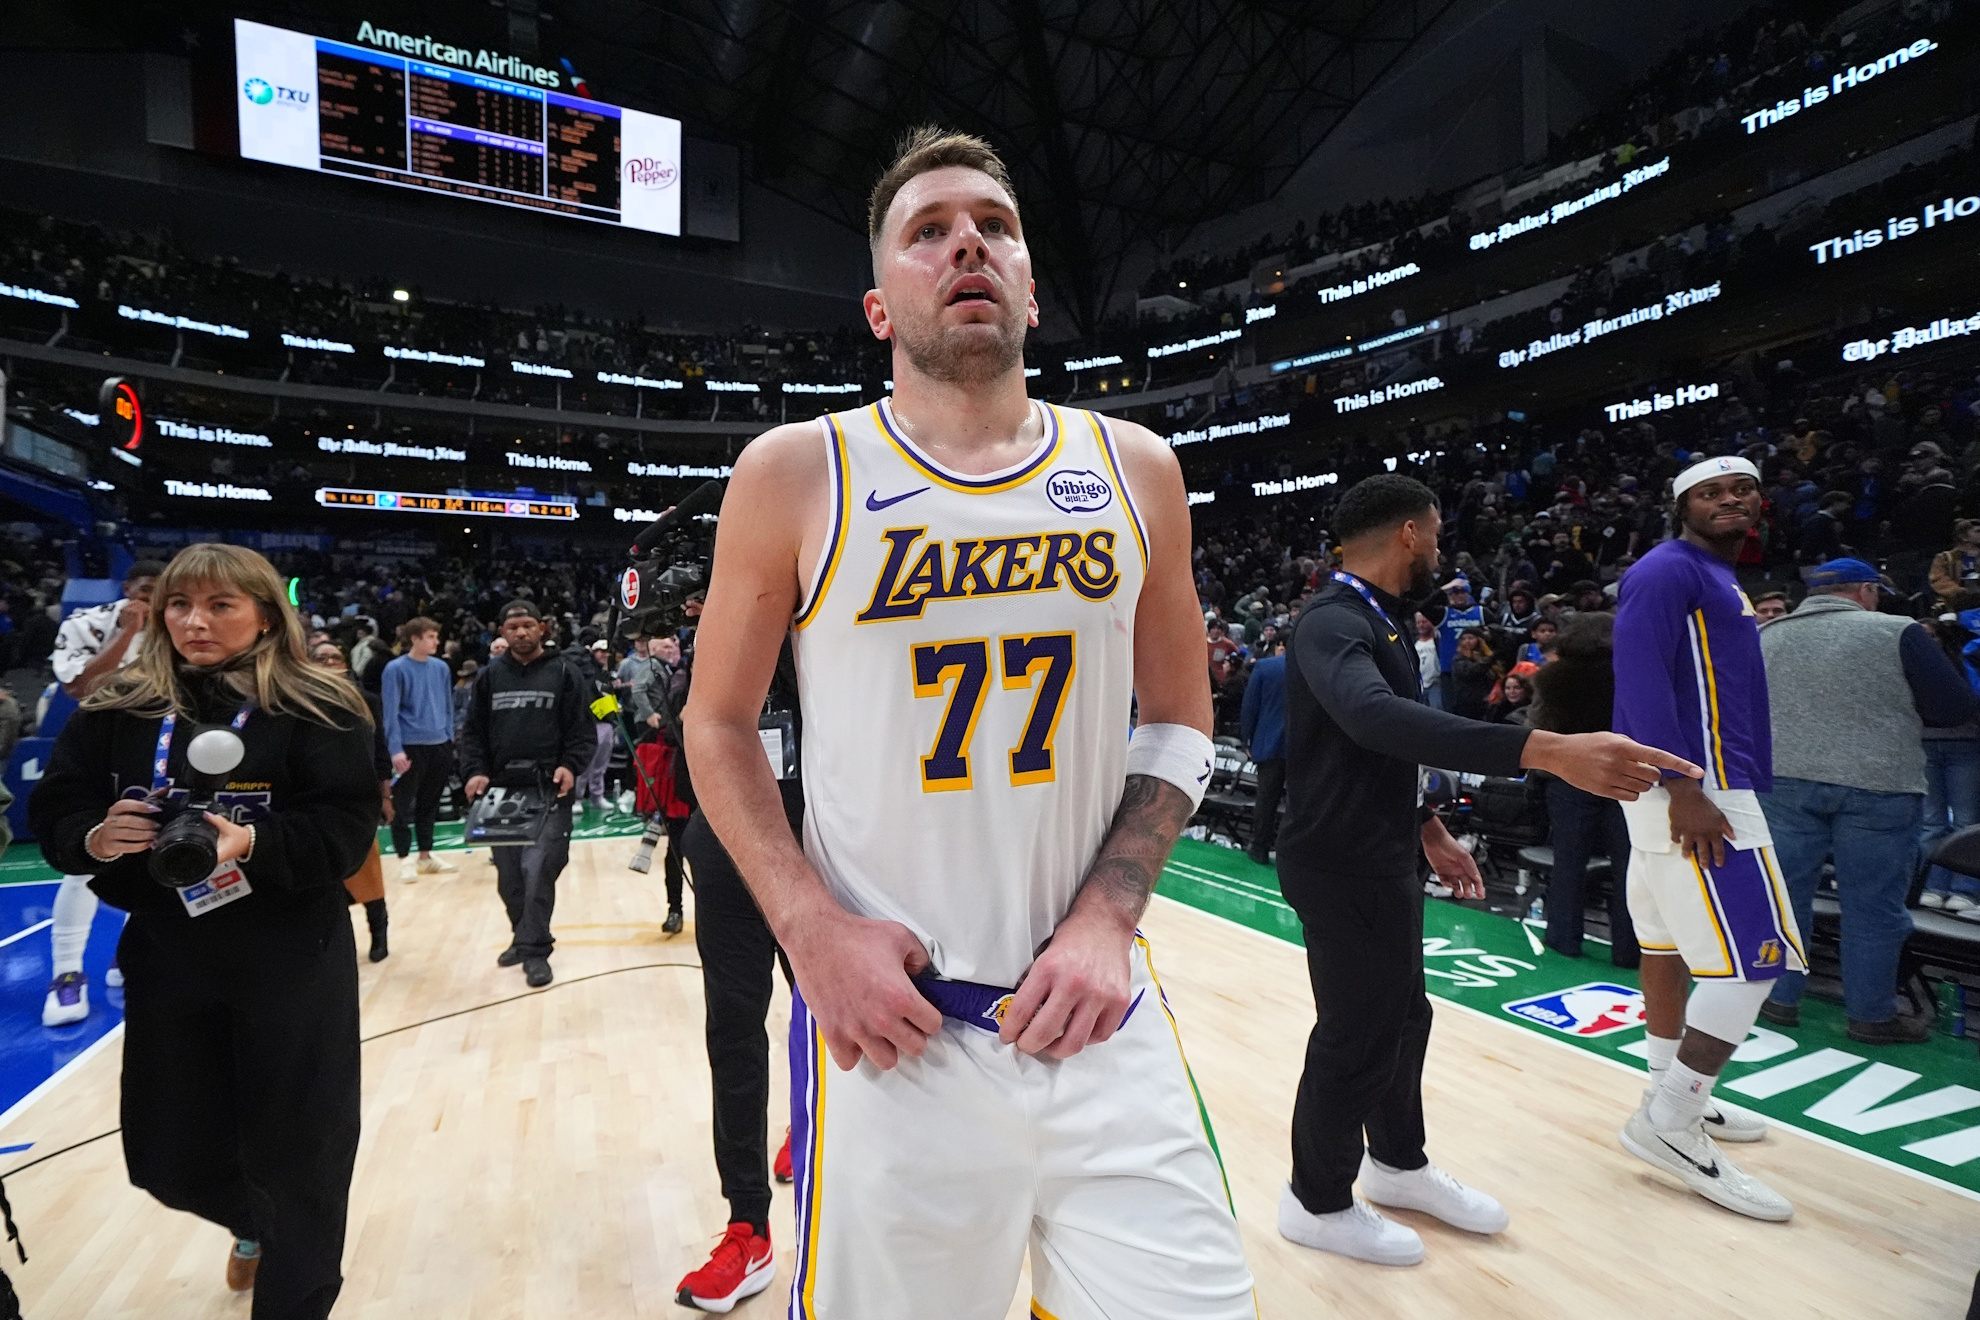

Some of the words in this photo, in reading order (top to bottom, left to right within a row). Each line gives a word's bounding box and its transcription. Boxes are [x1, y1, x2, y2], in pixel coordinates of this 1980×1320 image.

[356, 20, 475, 68] American
[474, 49, 561, 89] Airlines
[276, 86, 310, 103] TXU
[1741, 99, 1800, 133] This
[1804, 86, 1829, 107] is
[1833, 39, 1938, 94] Home.
[624, 158, 674, 186] Pepper
[644, 157, 662, 171] Dr
[1470, 232, 1497, 250] The
[1498, 211, 1549, 242] Dallas
[1551, 182, 1621, 224] Morning
[1623, 157, 1669, 192] News
[1810, 229, 1883, 263] This
[1888, 217, 1919, 240] is
[1318, 285, 1352, 303] This
[1353, 280, 1367, 294] is
[1368, 263, 1420, 289] Home.
[1499, 350, 1527, 368] The
[1528, 329, 1581, 360] Dallas
[1584, 304, 1663, 343] Morning
[1666, 281, 1720, 315] News
[1843, 339, 1889, 361] The
[1334, 394, 1369, 413] This
[1370, 390, 1385, 405] is
[1386, 377, 1444, 400] Home.
[1604, 399, 1652, 422] This
[1654, 394, 1674, 411] is
[156, 421, 198, 439] This
[199, 426, 215, 441] is
[216, 428, 272, 446] Home.
[506, 453, 535, 467] This
[535, 455, 548, 468] is
[549, 456, 592, 471] Home.
[164, 480, 201, 496] This
[201, 483, 217, 497] is
[217, 484, 272, 500] Home.
[1052, 480, 1107, 499] bibigo
[420, 498, 440, 509] 110
[470, 501, 490, 512] 116
[854, 525, 1121, 625] LAKERS
[491, 690, 556, 711] ESPN
[910, 630, 1076, 793] 77
[1516, 1004, 1571, 1026] NBA
